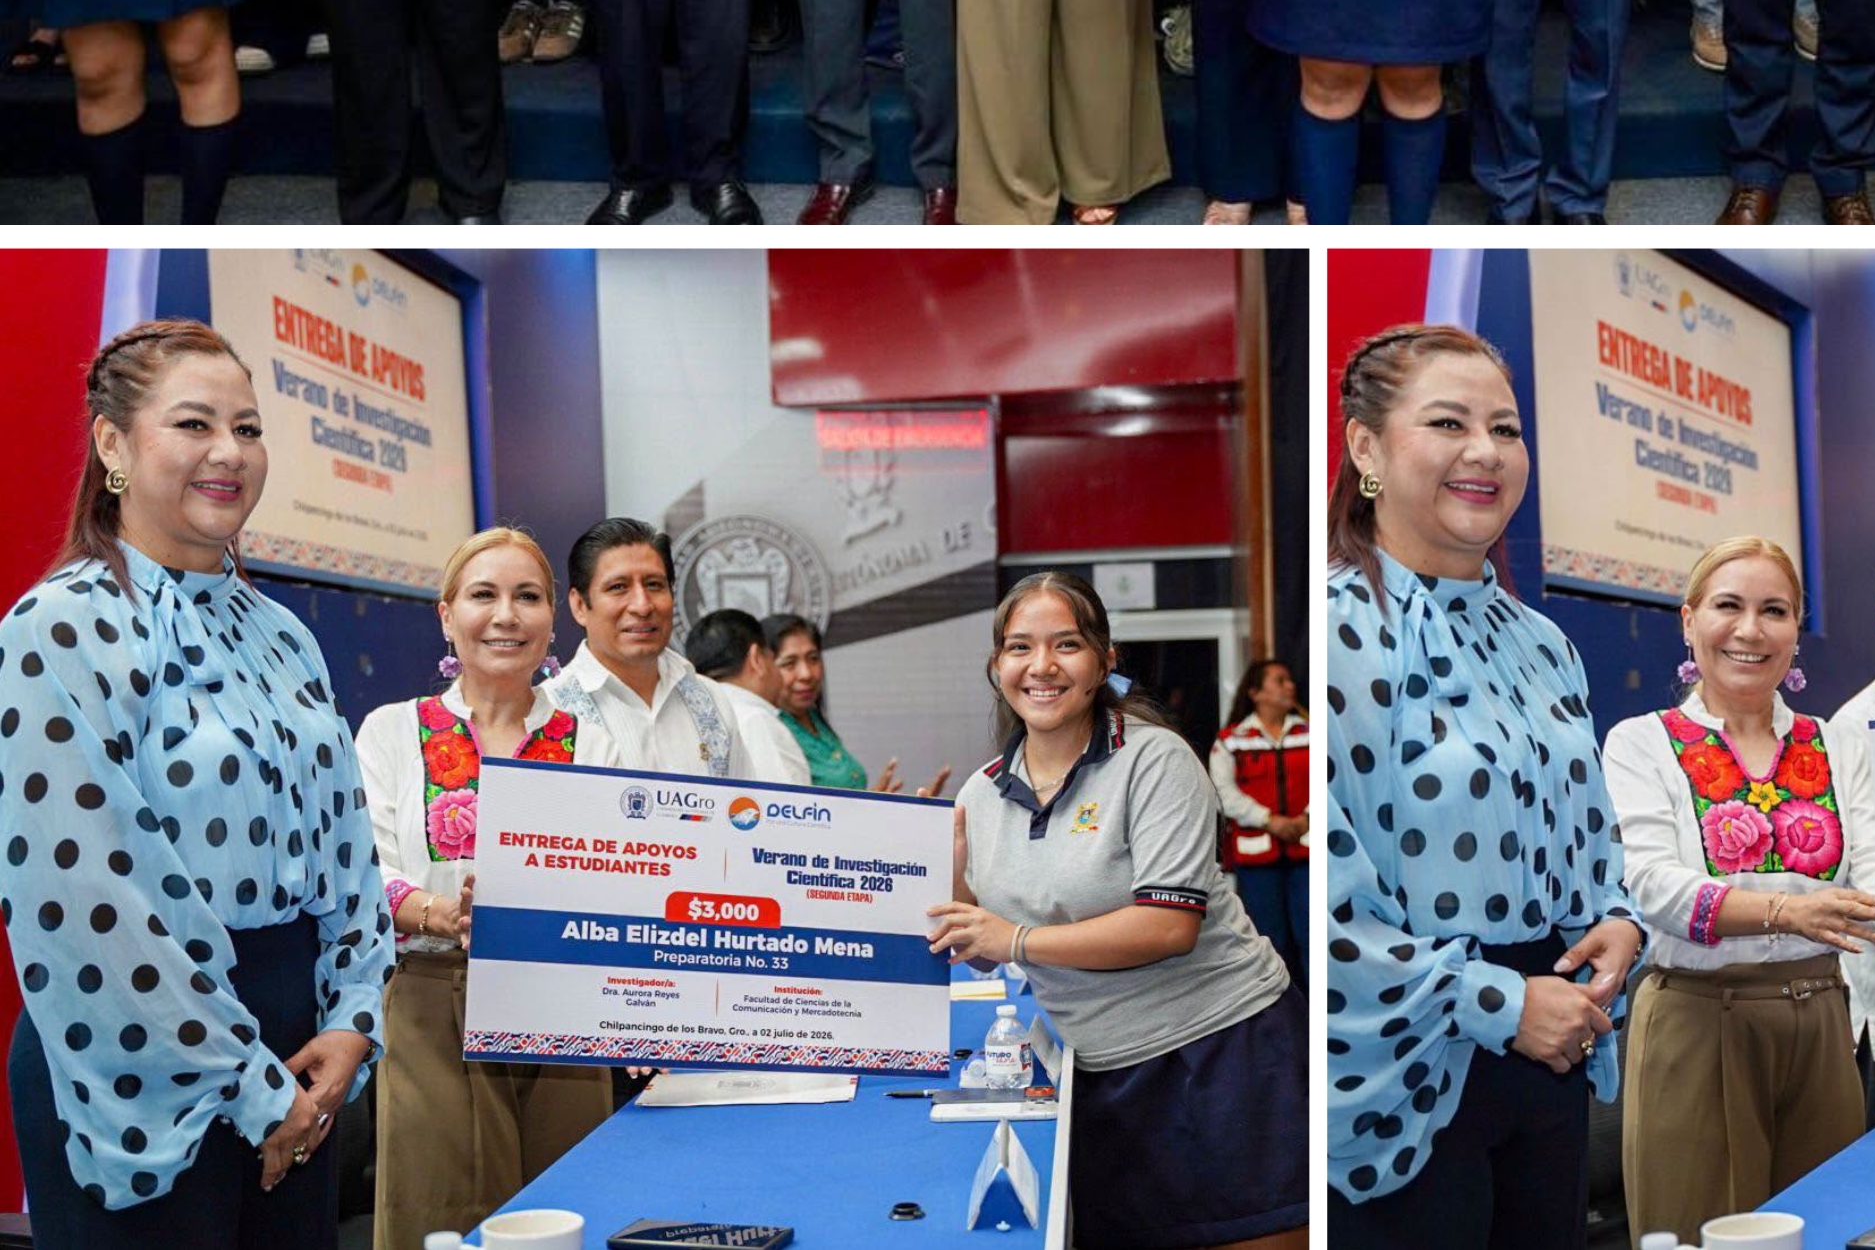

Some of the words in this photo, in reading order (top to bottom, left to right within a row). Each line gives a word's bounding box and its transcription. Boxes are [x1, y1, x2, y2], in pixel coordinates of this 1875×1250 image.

[657, 791, 715, 809] UAGro
[499, 831, 587, 852] ENTREGA
[592, 838, 617, 854] DE
[622, 841, 697, 860] APOYOS
[524, 852, 539, 867] A
[544, 854, 671, 876] ESTUDIANTES
[752, 847, 807, 867] Verano
[811, 854, 829, 869] de
[834, 855, 927, 877] Investigación
[786, 869, 855, 889] Científica
[860, 875, 893, 892] 2026
[806, 888, 845, 901] (SEGUNDA
[846, 892, 873, 904] ETAPA)
[1151, 892, 1196, 905] UAGro
[688, 898, 759, 921] $3,000
[561, 920, 619, 942] Alba
[626, 924, 707, 947] Elizdel
[714, 930, 808, 954] Hurtado
[814, 936, 873, 958] Mena
[654, 949, 741, 967] Preparatoria
[745, 954, 768, 968] No.
[771, 956, 789, 970] 33
[607, 976, 676, 988] Investigador/a:
[774, 985, 822, 995] Institución:
[602, 987, 620, 996] Dra.
[622, 988, 652, 997] Aurora
[654, 989, 680, 1000] Reyes
[625, 998, 656, 1007] Galván
[743, 994, 780, 1004] Facultad
[782, 996, 793, 1005] de
[794, 997, 829, 1007] Ciencias
[830, 999, 842, 1007] de
[843, 1000, 852, 1008] la
[732, 1003, 792, 1014] Comunicación
[794, 1008, 800, 1016] y
[801, 1007, 862, 1018] Mercadotecnia
[599, 1020, 665, 1034] Chilpancingo
[666, 1024, 679, 1033] de
[681, 1024, 695, 1033] los
[697, 1025, 726, 1035] Bravo,
[759, 1028, 771, 1037] 02
[772, 1028, 794, 1039] julio
[796, 1030, 808, 1038] de
[810, 1030, 833, 1040] 2026.
